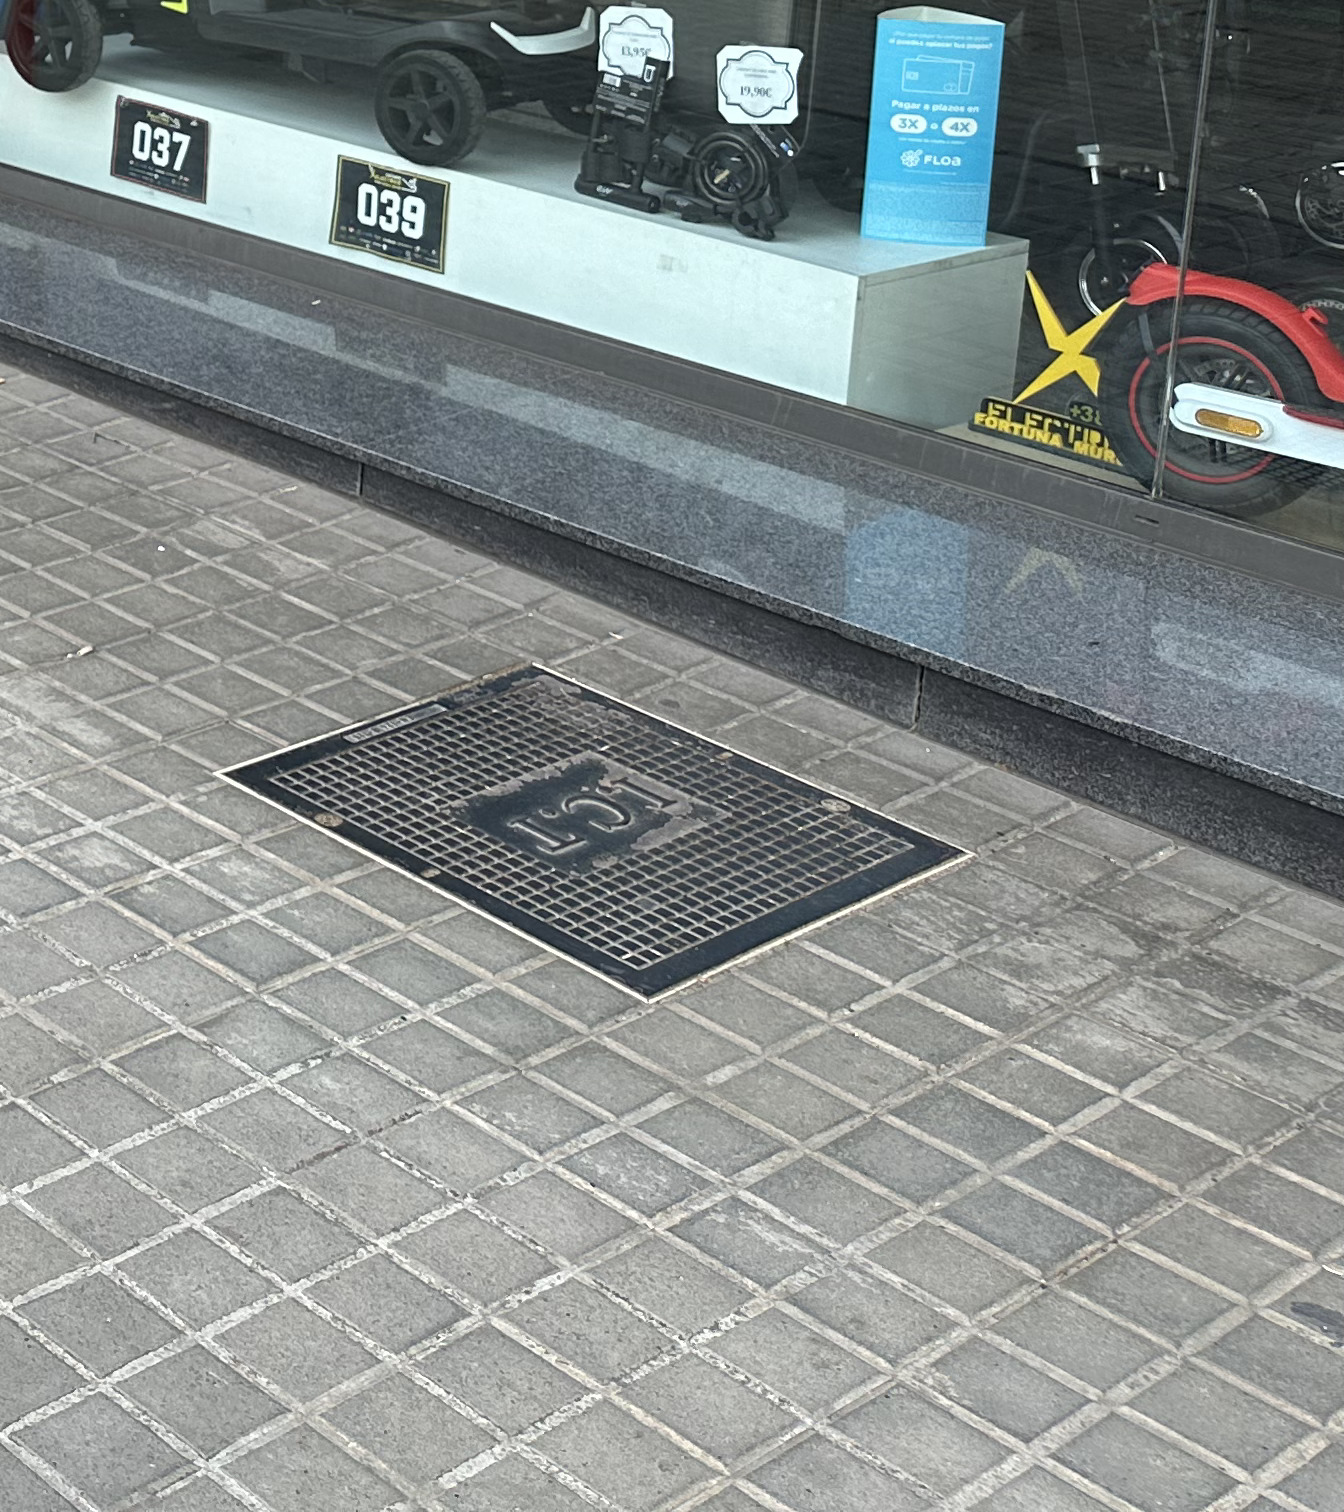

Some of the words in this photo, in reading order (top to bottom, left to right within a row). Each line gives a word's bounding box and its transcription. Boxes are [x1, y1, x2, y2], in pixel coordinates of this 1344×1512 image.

[740, 85, 772, 98] 19,90€
[891, 99, 921, 110] Pagar
[931, 102, 965, 113] plazos
[967, 105, 980, 113] en
[898, 118, 919, 130] 3X
[949, 121, 971, 133] 4X
[132, 120, 191, 172] 037
[357, 182, 426, 240] 039
[974, 412, 1064, 448] FORTUNA
